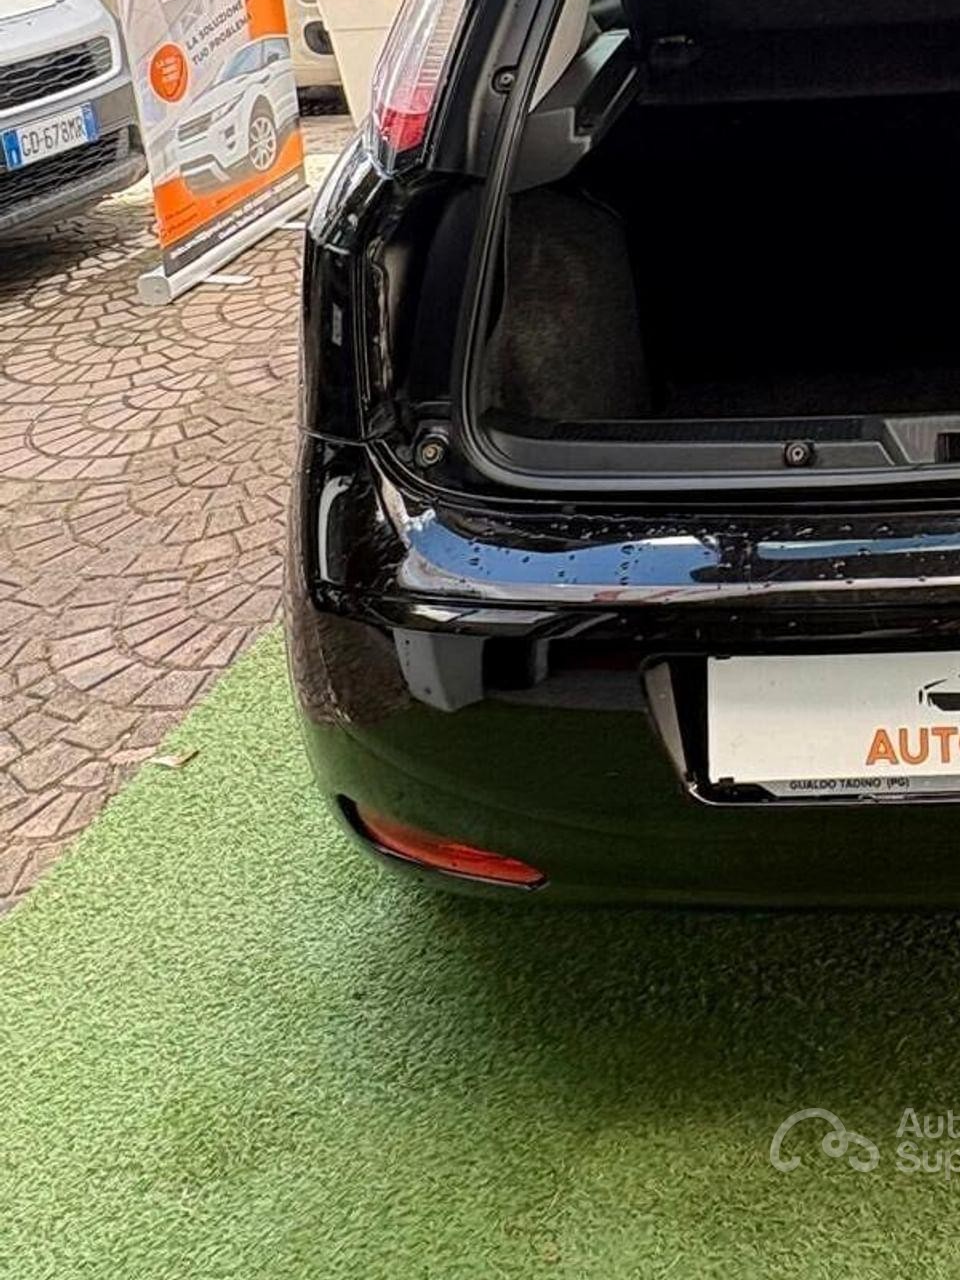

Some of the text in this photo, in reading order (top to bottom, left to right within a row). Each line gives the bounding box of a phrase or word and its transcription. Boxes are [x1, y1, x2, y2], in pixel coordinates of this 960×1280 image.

[789, 776, 910, 791] GUALDO TADINO (PG)
